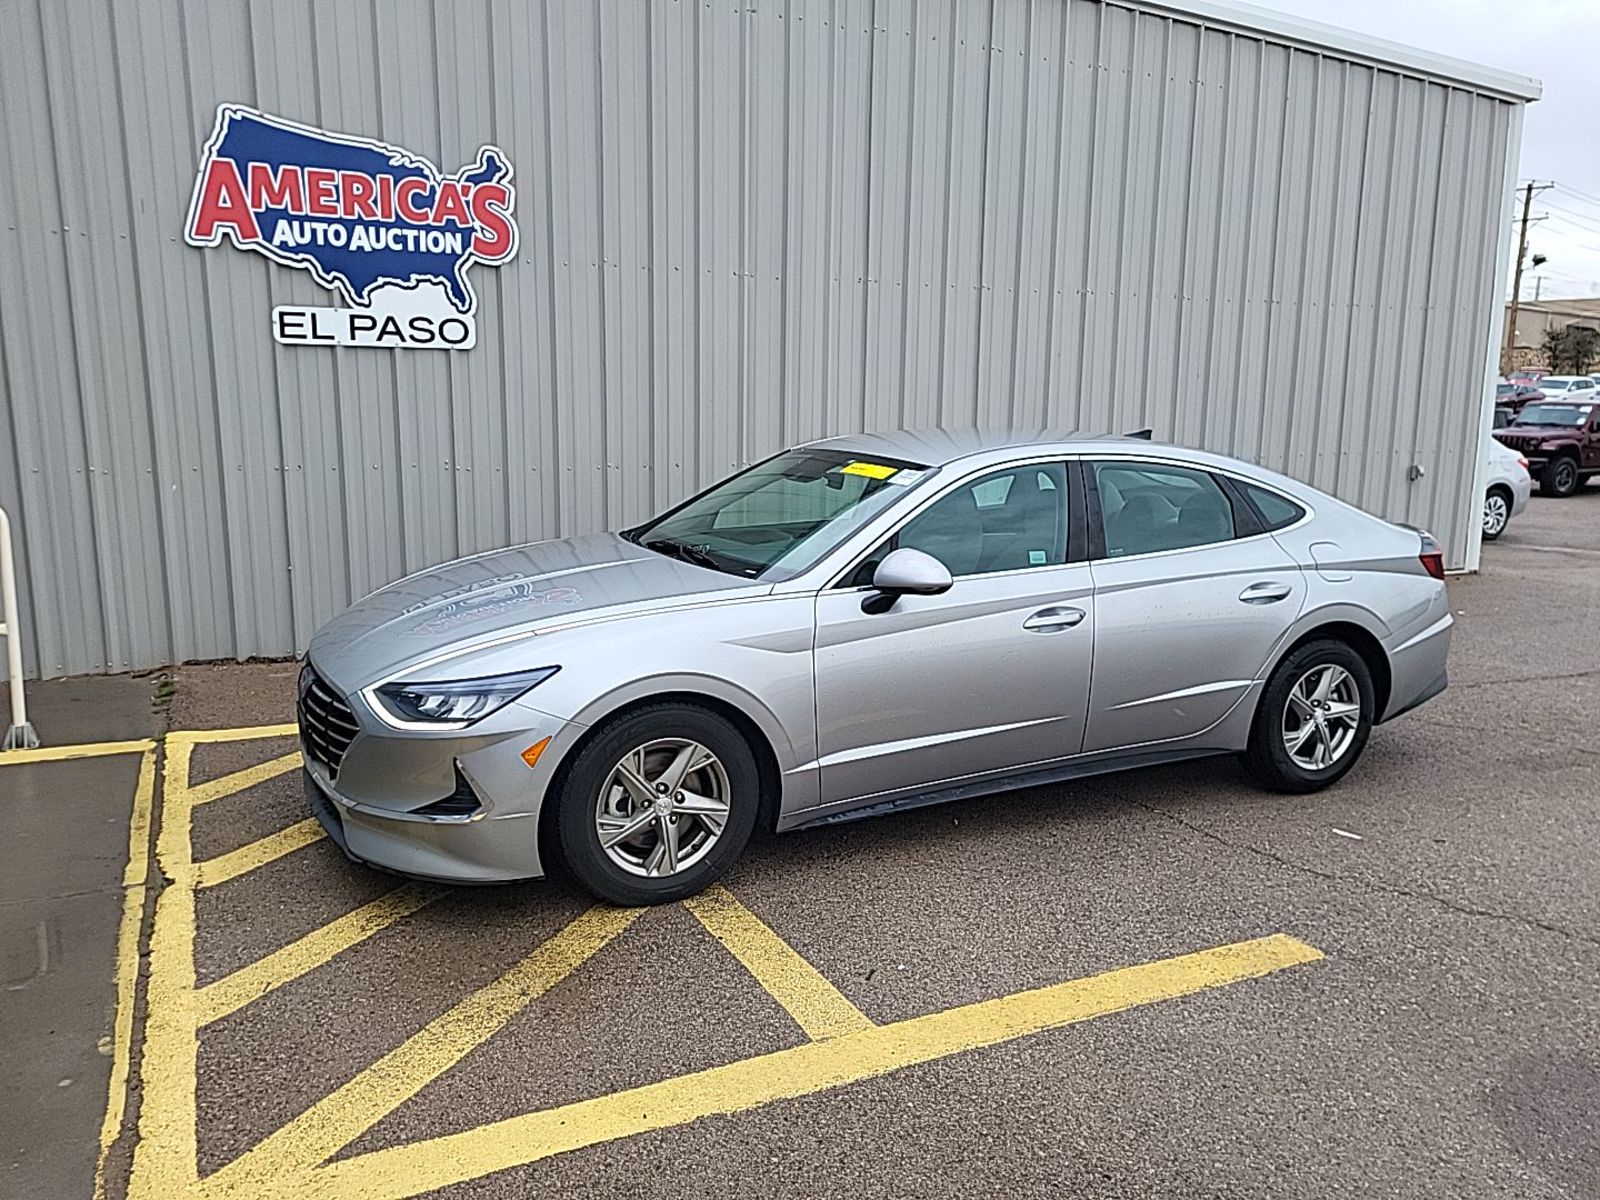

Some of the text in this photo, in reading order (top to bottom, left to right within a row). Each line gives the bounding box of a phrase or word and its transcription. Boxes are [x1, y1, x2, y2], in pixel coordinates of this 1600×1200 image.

[193, 158, 511, 258] AMERICA'S
[272, 219, 463, 255] AUTO AUCTION
[278, 310, 470, 344] EL PASO
